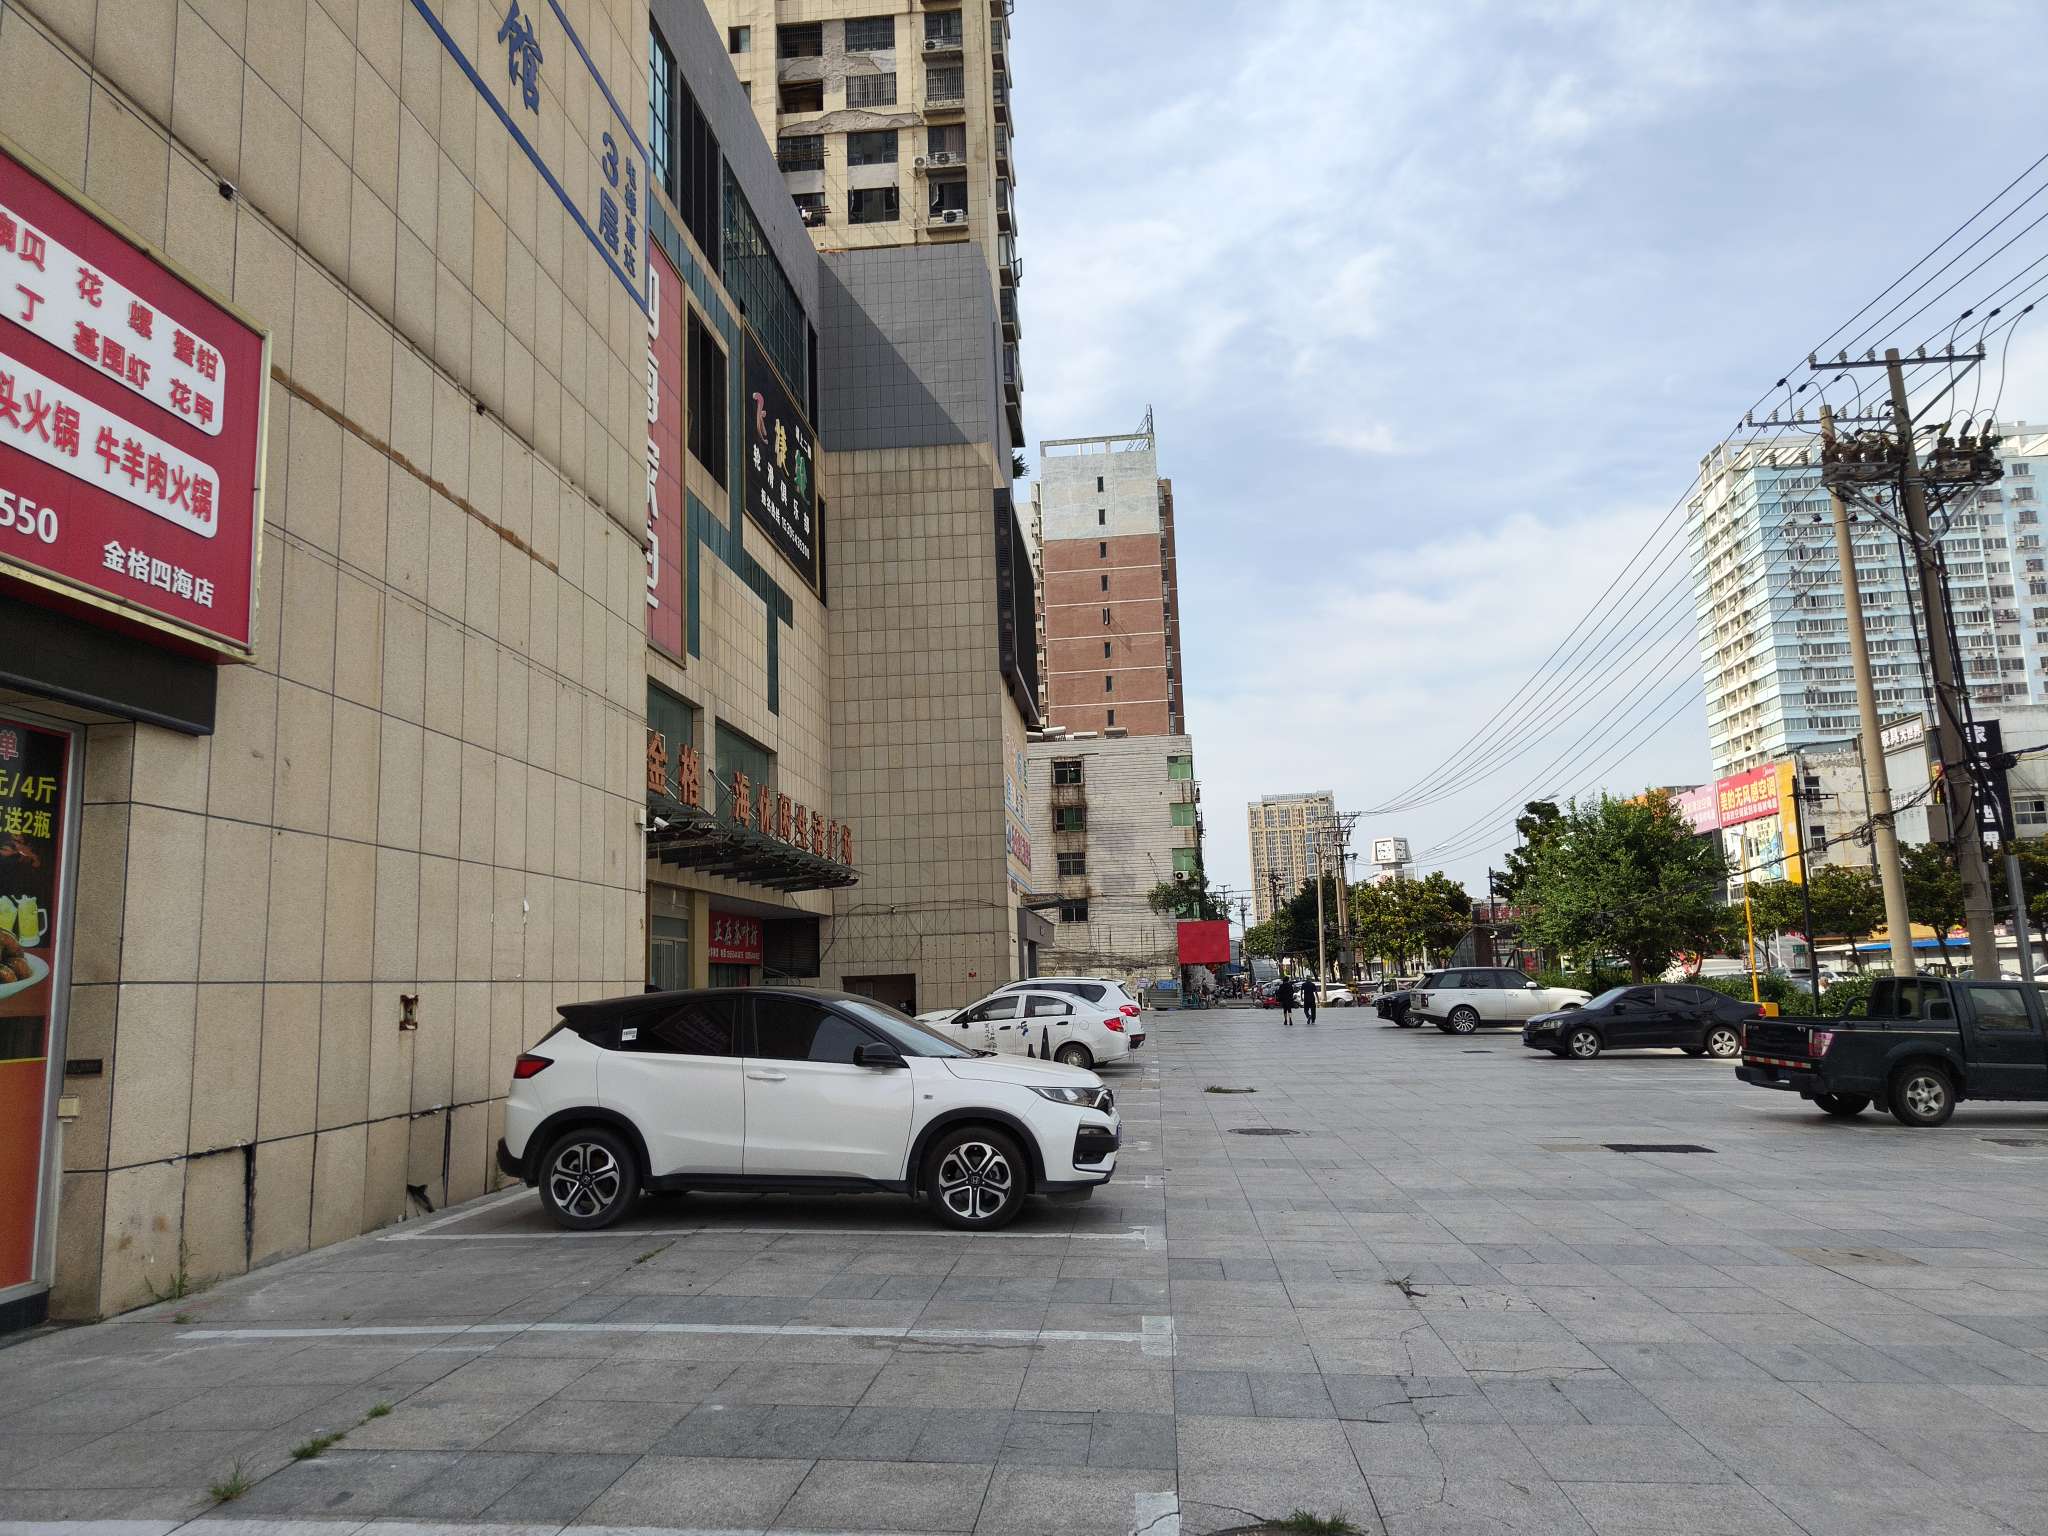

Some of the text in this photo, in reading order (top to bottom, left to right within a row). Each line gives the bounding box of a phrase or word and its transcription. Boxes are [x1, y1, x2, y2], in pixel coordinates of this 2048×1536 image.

[16, 283, 214, 424] 丁 基围虾 花甲
[95, 425, 214, 524] 牛羊肉火锅
[103, 540, 215, 609] 金格四海店
[0, 806, 52, 839] 送2瓶
